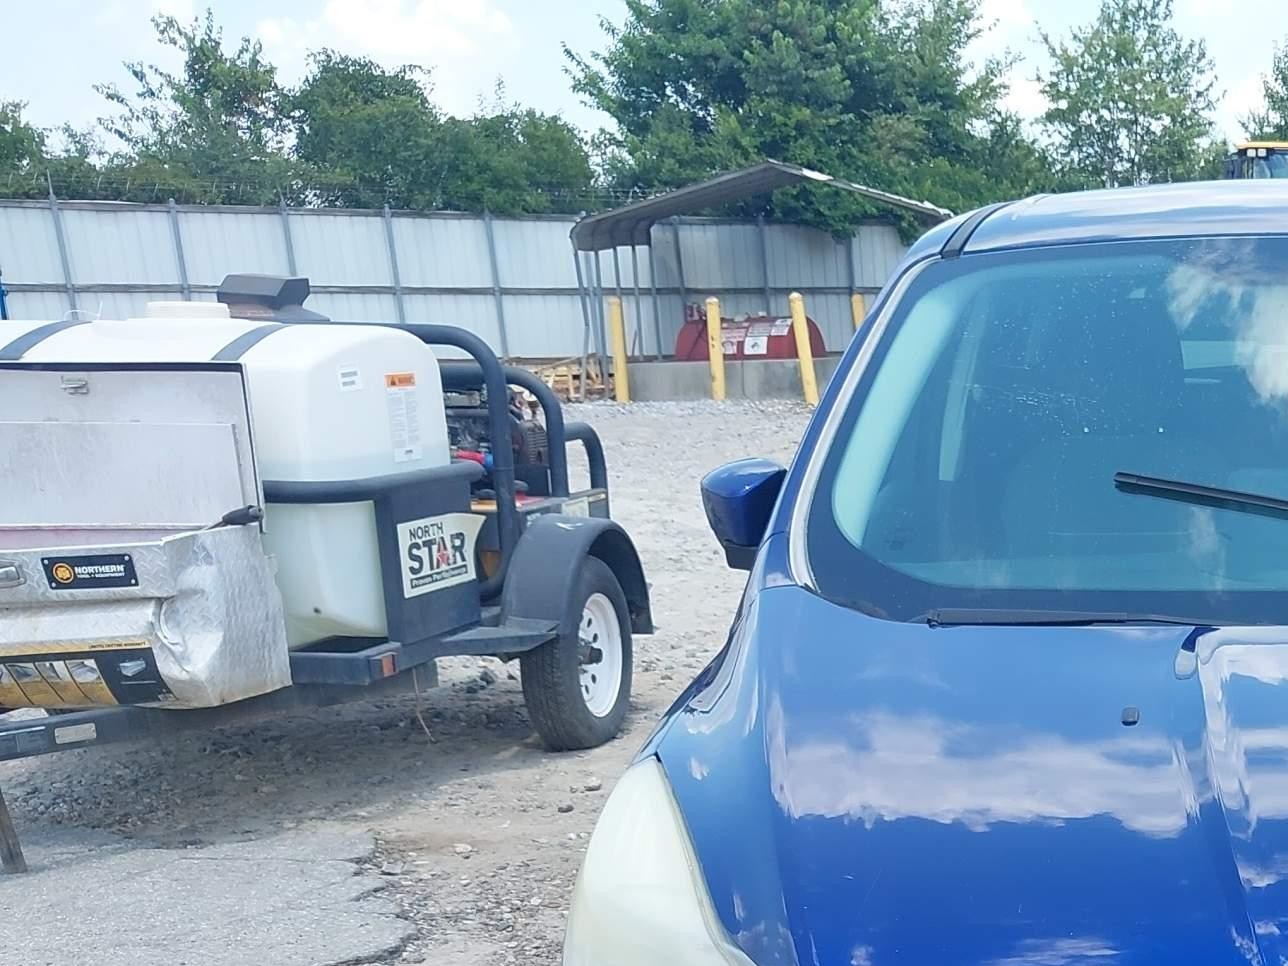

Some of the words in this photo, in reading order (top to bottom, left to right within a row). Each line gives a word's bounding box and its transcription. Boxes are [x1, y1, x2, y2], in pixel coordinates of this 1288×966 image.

[408, 521, 444, 541] NORTH
[407, 531, 467, 575] STAR
[74, 564, 125, 574] NORTHERN
